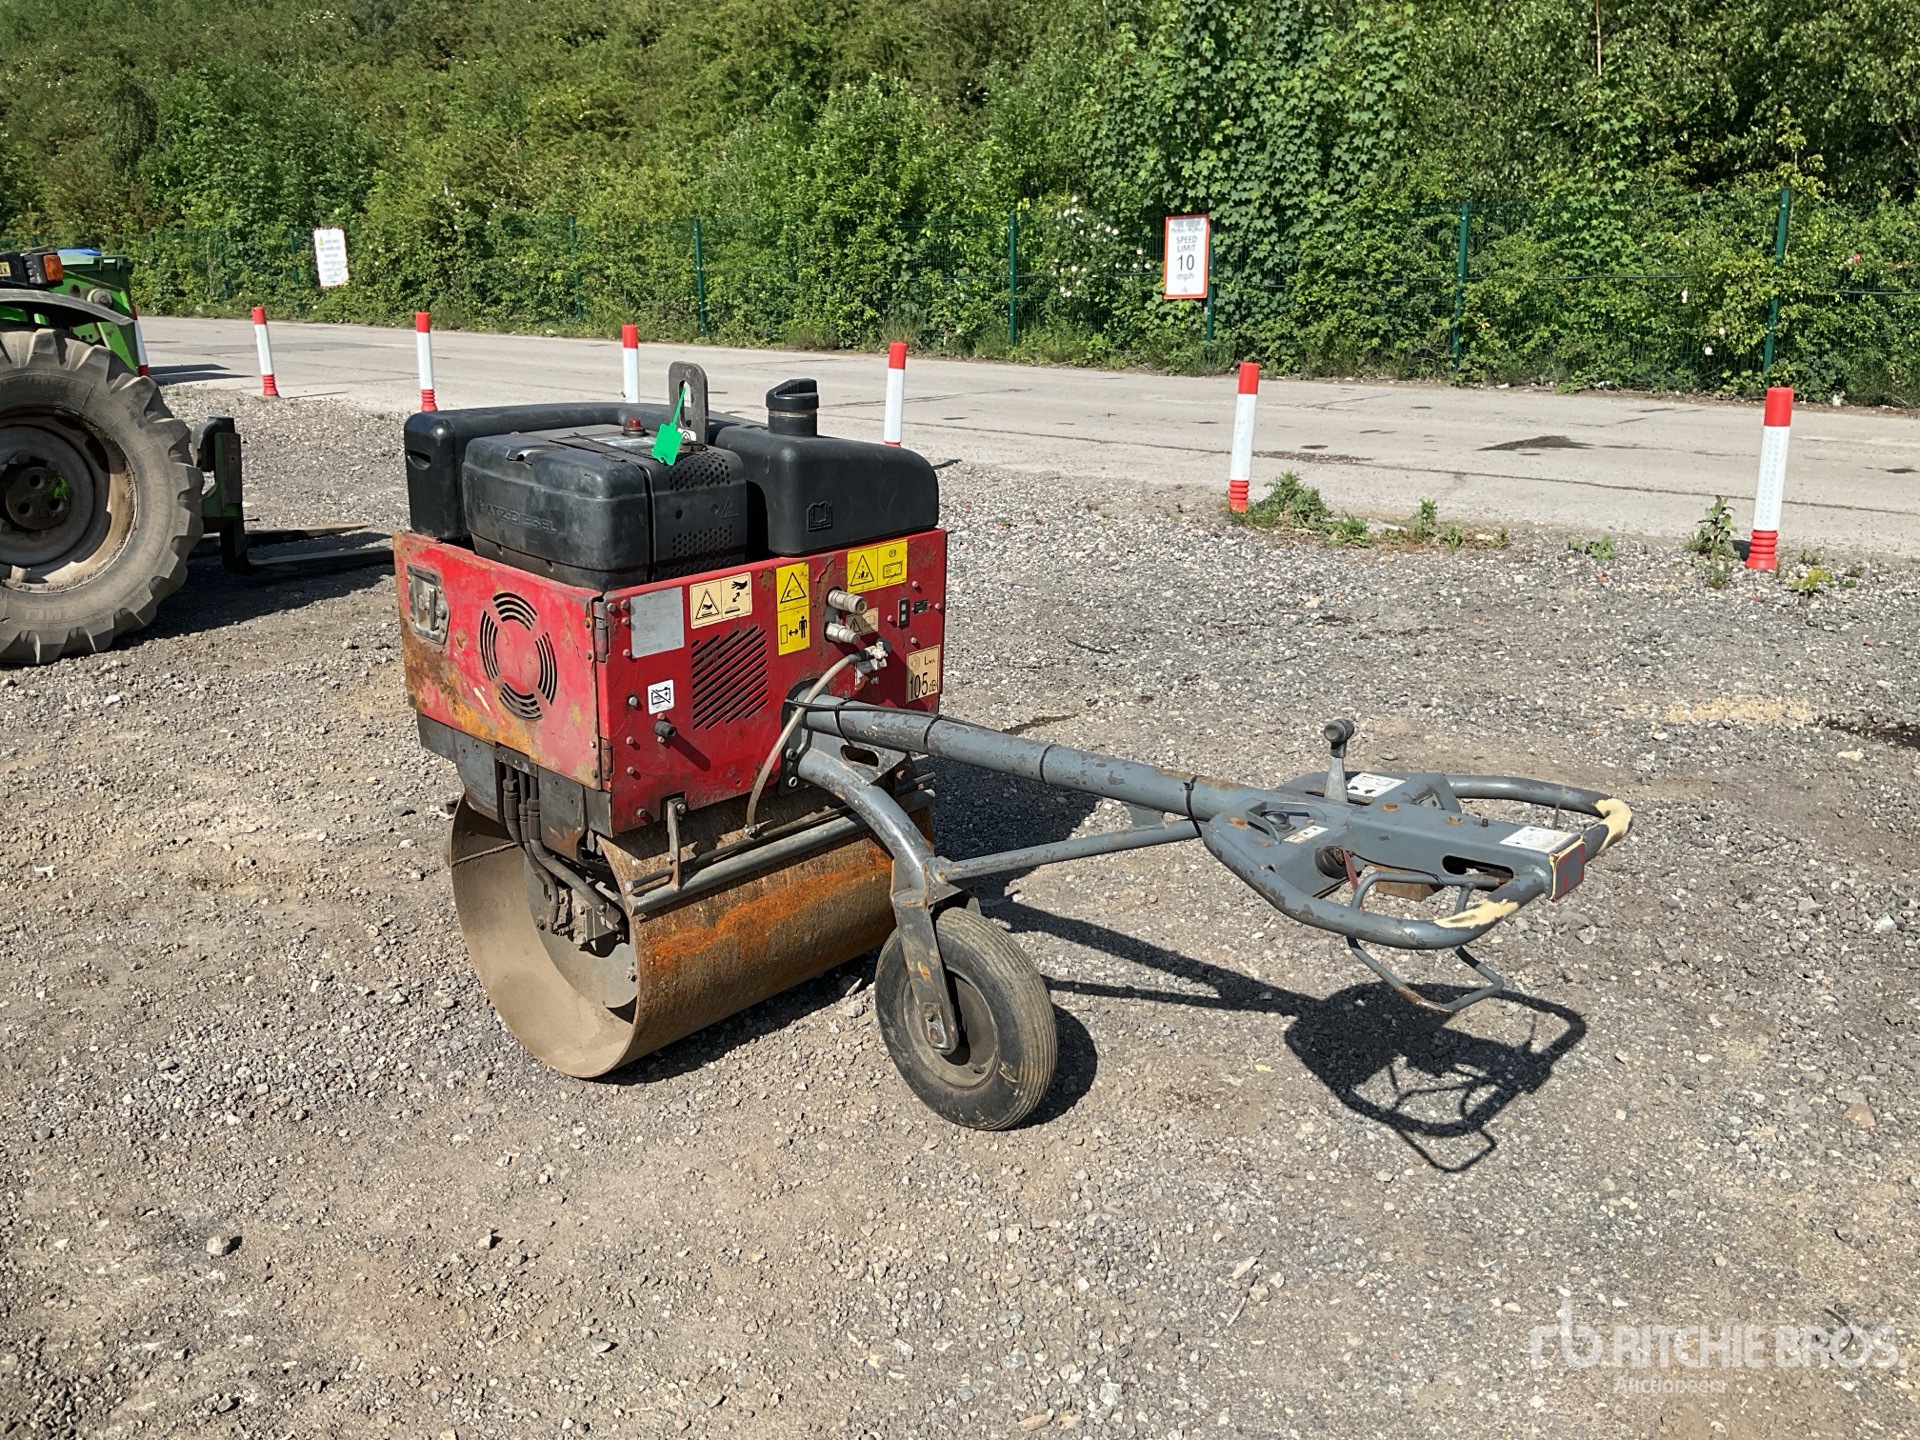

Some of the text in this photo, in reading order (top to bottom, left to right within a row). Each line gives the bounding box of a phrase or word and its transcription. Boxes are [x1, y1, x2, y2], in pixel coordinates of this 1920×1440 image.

[1176, 236, 1198, 244] SPEED
[1177, 244, 1196, 252] LIMIT
[1177, 254, 1195, 271] 10
[1177, 272, 1195, 282] mph
[909, 672, 929, 700] 105
